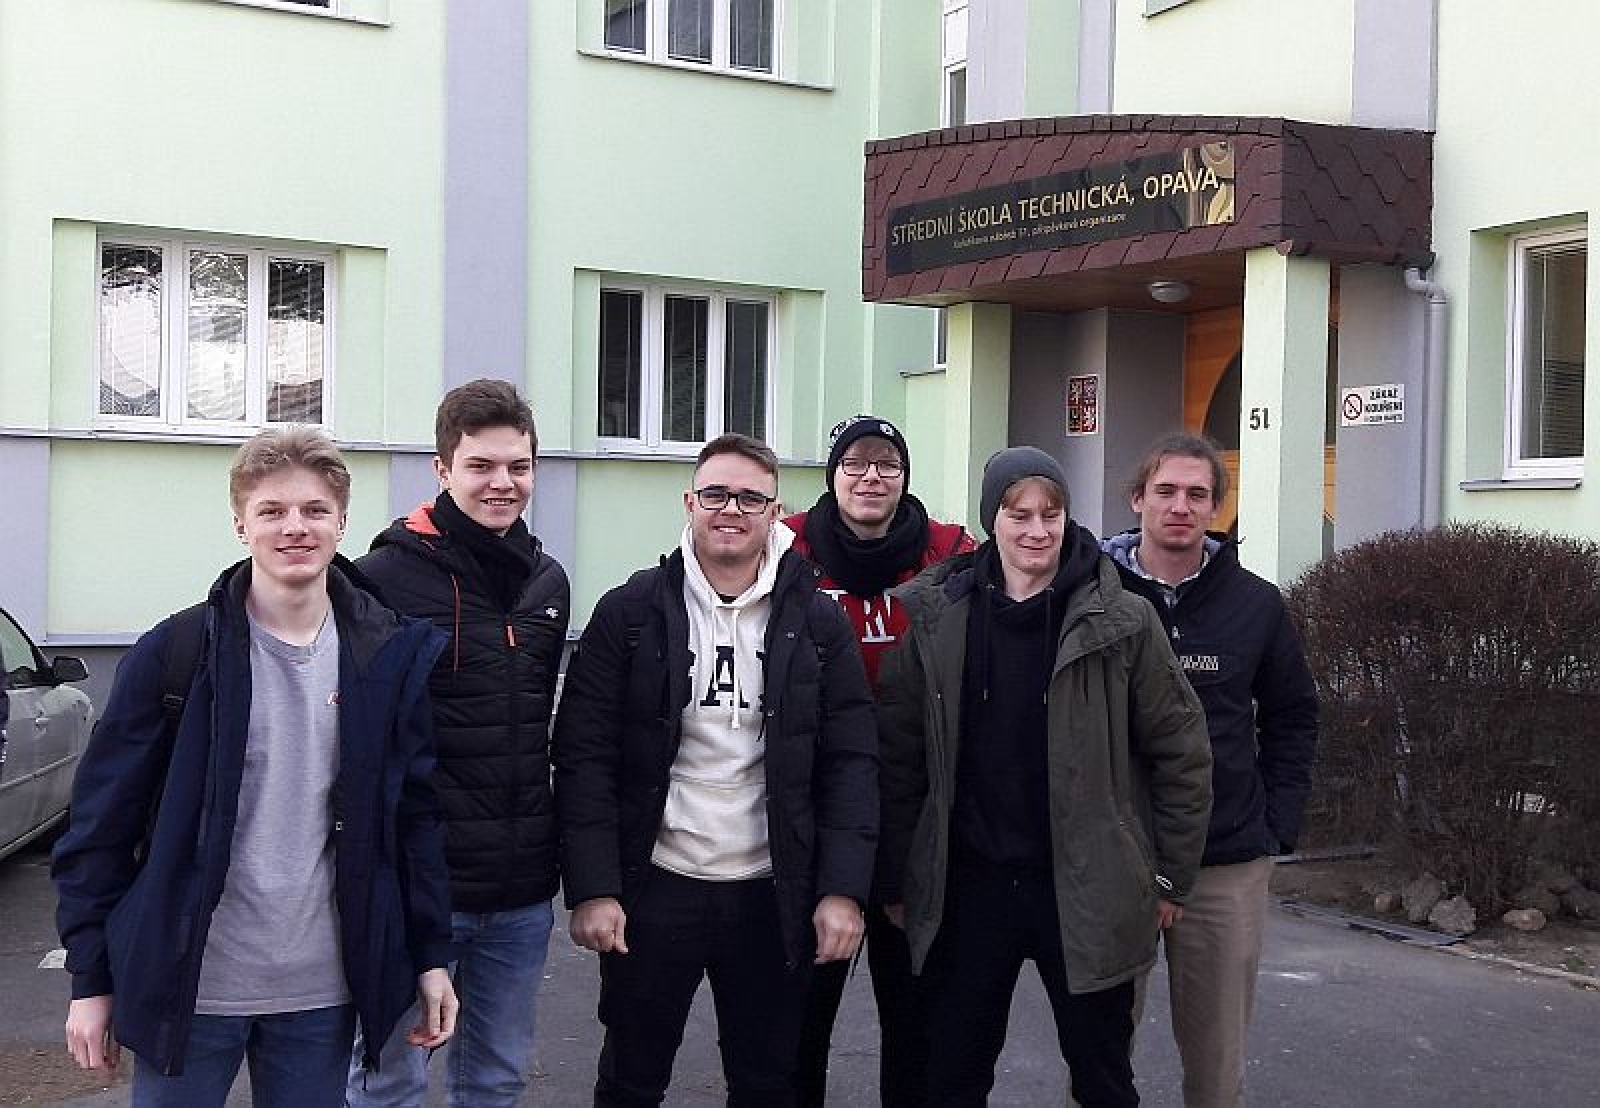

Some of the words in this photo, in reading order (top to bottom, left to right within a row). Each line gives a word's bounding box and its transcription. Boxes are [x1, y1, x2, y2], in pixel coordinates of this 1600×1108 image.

[892, 208, 955, 246] STŘEDNÍ
[958, 203, 1012, 233] ŠKOLA
[1018, 175, 1135, 220] TECHNICKÁ,
[1250, 407, 1271, 431] 51
